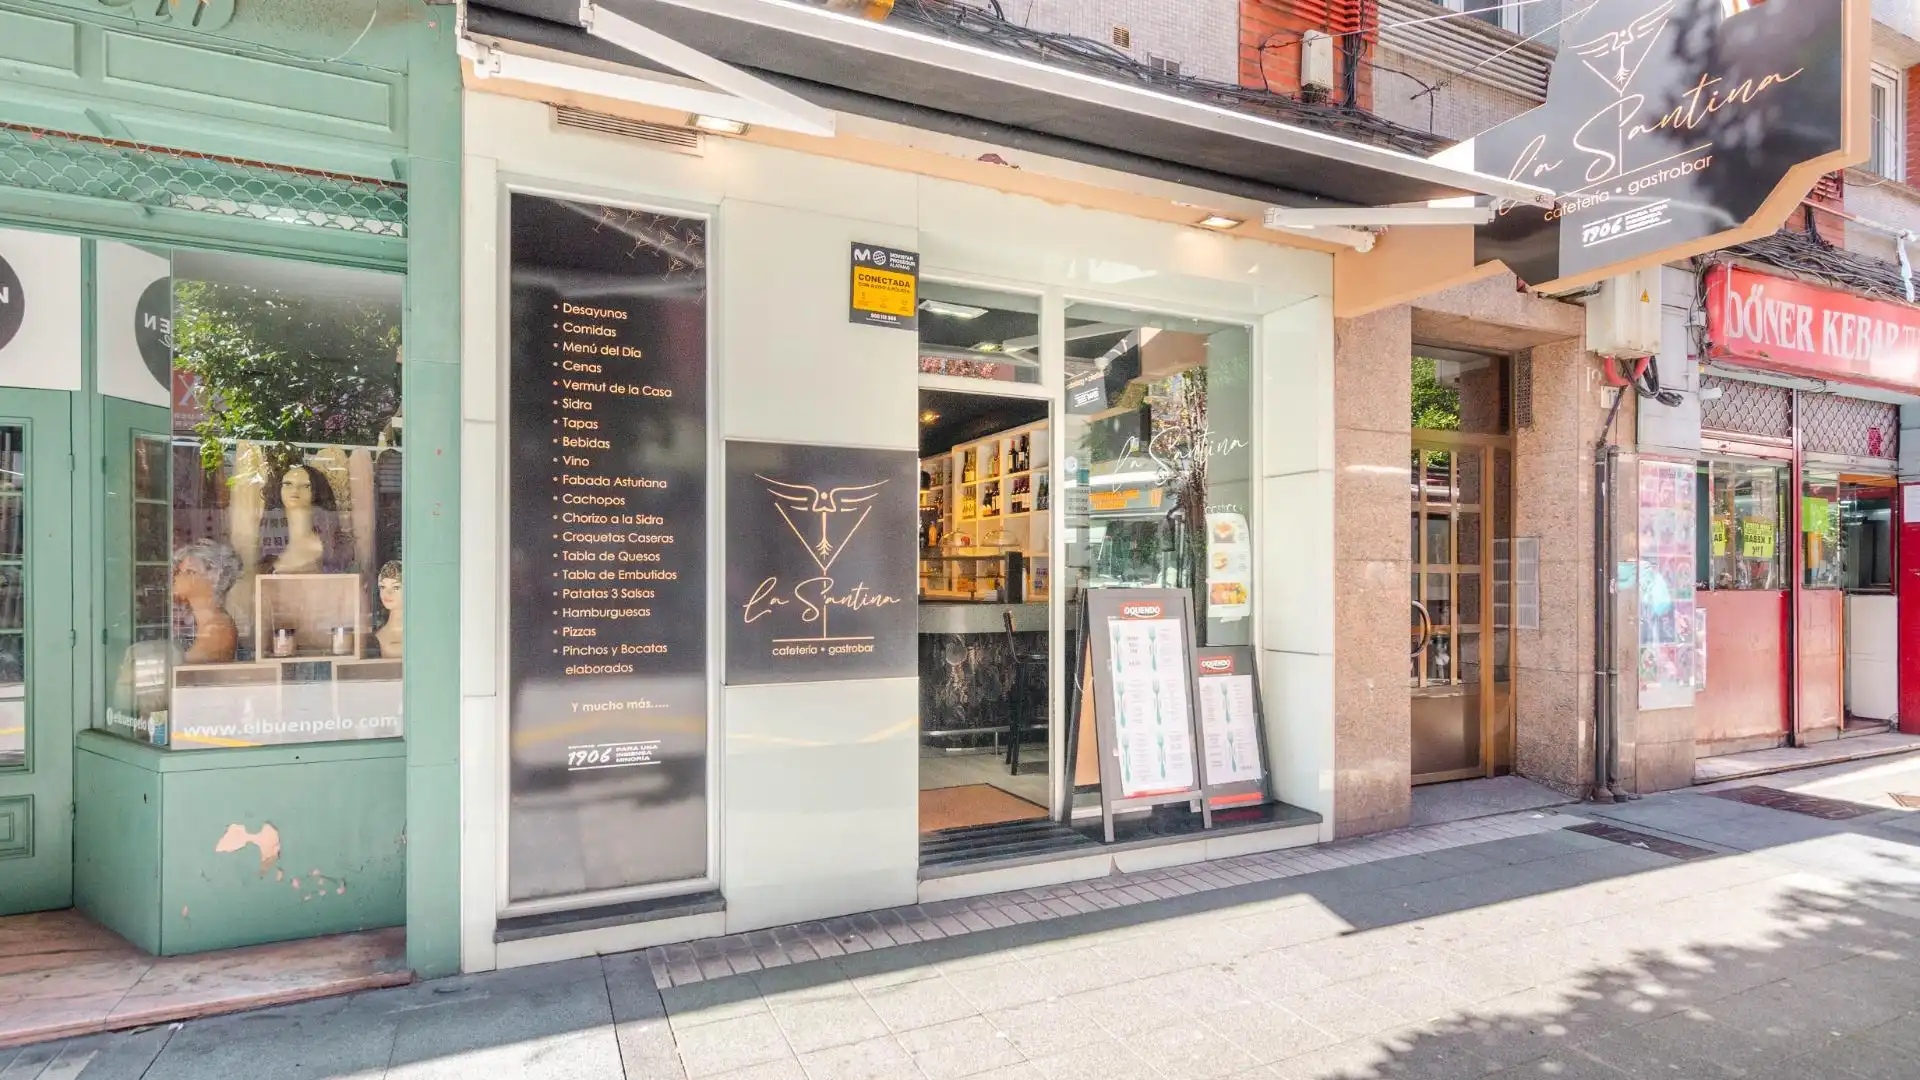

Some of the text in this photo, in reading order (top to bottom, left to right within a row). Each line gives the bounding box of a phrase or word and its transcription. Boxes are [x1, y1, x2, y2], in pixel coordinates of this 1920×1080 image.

[1573, 67, 1804, 182] Santina
[1544, 189, 1610, 222] cafetería
[1628, 155, 1713, 196] gastrobar
[1582, 216, 1623, 243] 1906
[858, 273, 911, 288] CONECTADA
[562, 303, 628, 320] Desayunos
[562, 322, 617, 338] Comidas
[562, 341, 642, 358] Menú del Día
[562, 360, 602, 373] Cenas
[562, 379, 673, 398] Vermut de la Casa
[562, 398, 592, 411] Sidra
[562, 417, 599, 430] Tapas
[562, 436, 611, 449] Bebidas
[562, 455, 590, 467] Vino
[1148, 425, 1249, 486] Santina
[562, 474, 667, 489] Fabada Asturiana
[562, 493, 626, 507] Cachopos
[562, 512, 664, 525] Chorizo a la Sidra
[562, 531, 674, 545] Croquetas Caseras
[562, 550, 661, 562] Tabla de Quesos
[562, 569, 678, 581] Tabla de Embutidos
[562, 588, 655, 599] Patatas 3 Salsas
[743, 576, 901, 624] La Santina
[562, 607, 651, 620] Hamburguesas
[1124, 606, 1161, 618] OQUENDO
[562, 626, 597, 637] Pizzas
[562, 643, 668, 657] Pinchos y Bocatas
[772, 643, 874, 657] cafetería gastrobar
[565, 662, 634, 676] elaborados
[571, 702, 579, 713] Y
[582, 700, 624, 712] mucho
[183, 714, 399, 738] www.elbuenpelo.com
[568, 747, 613, 766] 1906
